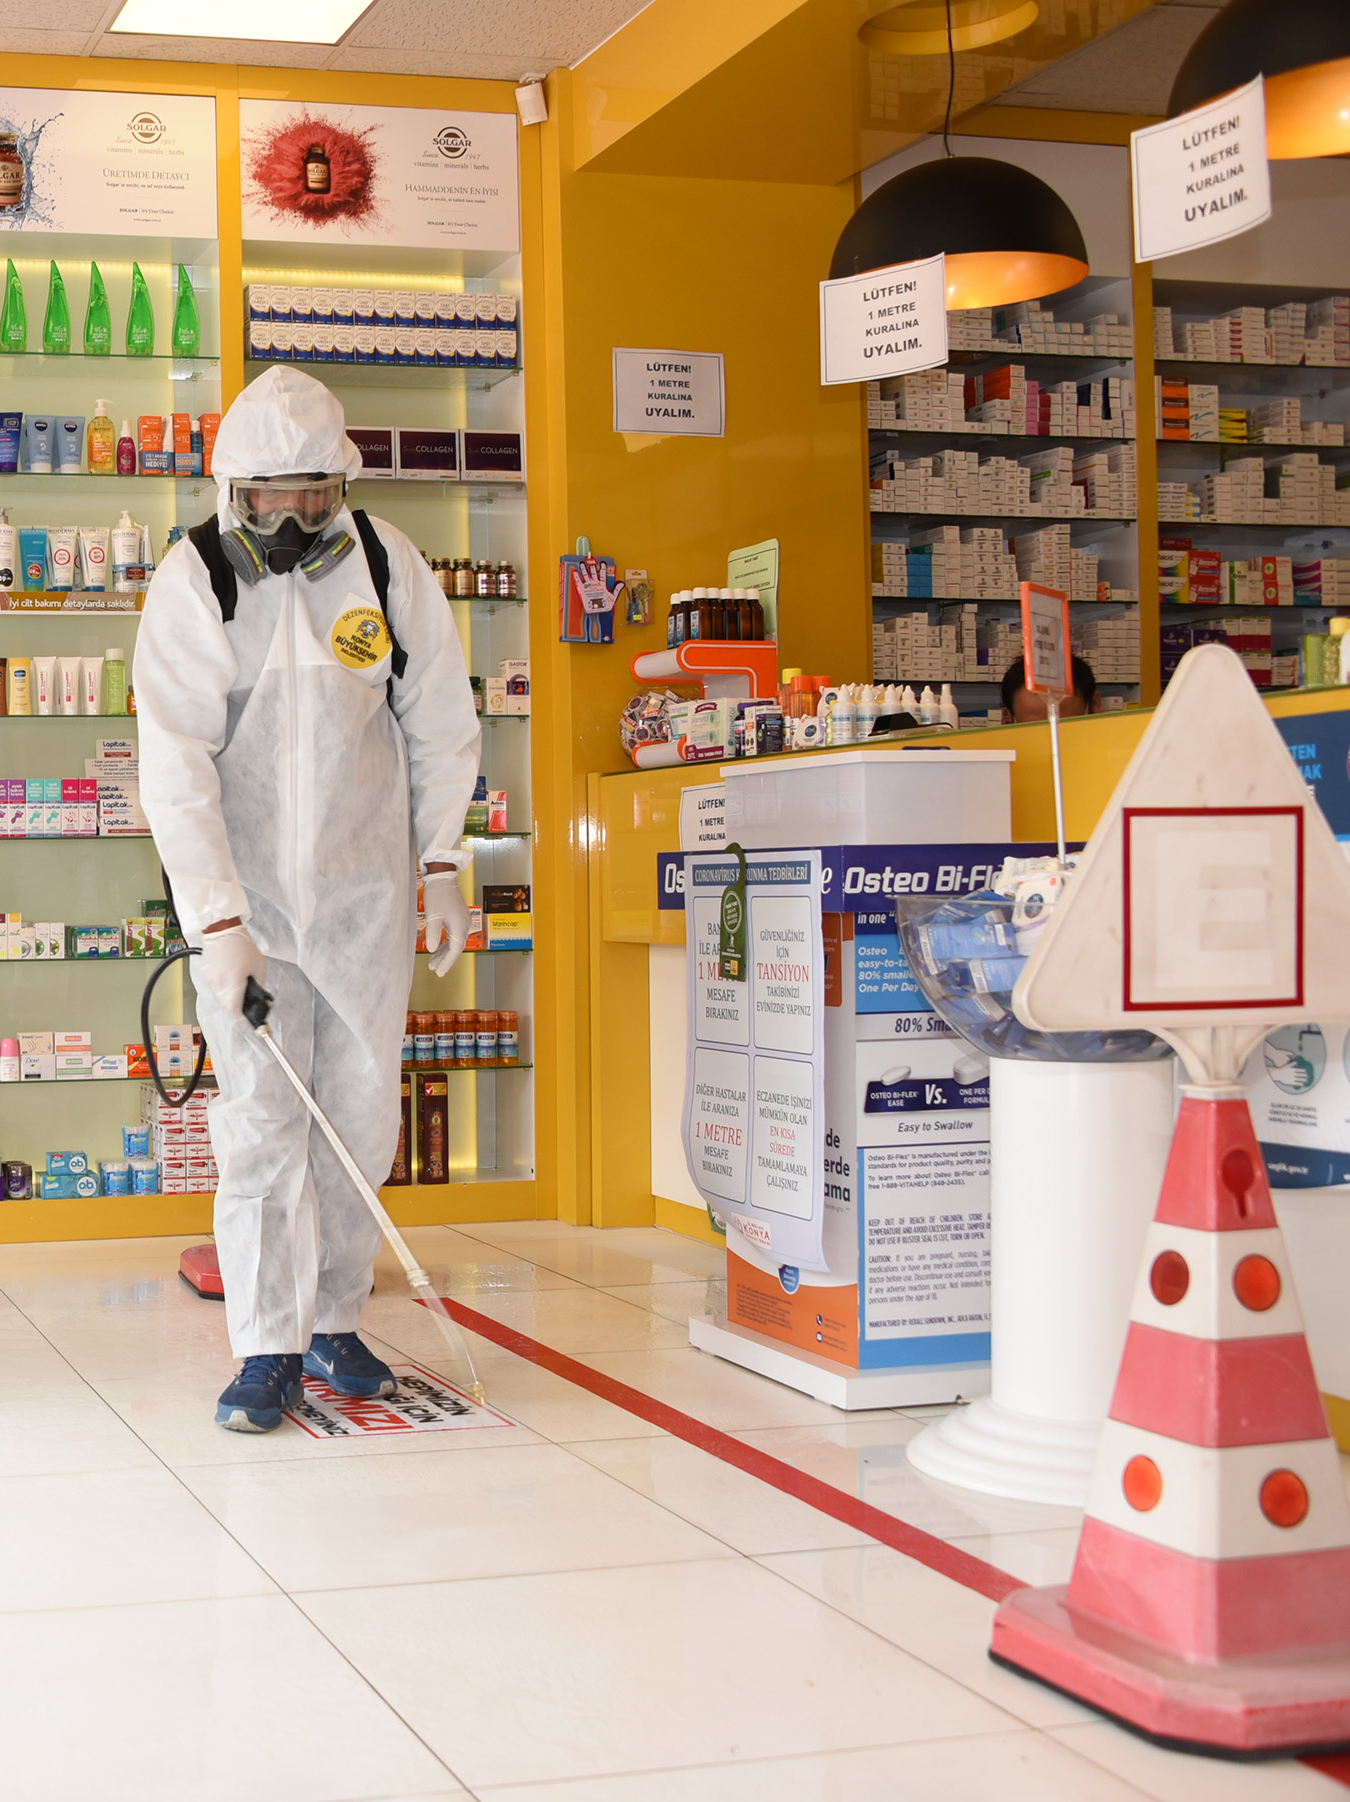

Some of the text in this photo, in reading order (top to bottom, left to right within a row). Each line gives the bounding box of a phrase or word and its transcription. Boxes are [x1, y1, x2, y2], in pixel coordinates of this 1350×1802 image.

[126, 122, 167, 132] SOLGAR
[1182, 114, 1240, 151] LÜTFEN!
[432, 137, 472, 148] SOLGAR
[414, 160, 438, 168] vitamins
[443, 162, 469, 170] minerals
[1188, 143, 1240, 172] 1 METRE
[102, 166, 190, 181] ÜRETİMDE DETAYCI
[1186, 163, 1244, 195] KURALINA
[405, 183, 468, 194] HAMMADDENİN
[470, 187, 480, 195] EN
[1184, 188, 1248, 222] UYALIM.
[863, 281, 917, 302] LÜTFEN!
[868, 302, 916, 320] 1 METRE
[865, 318, 919, 337] KURALINA
[864, 338, 922, 358] UYALIM.
[647, 362, 691, 373] LÜTFEN!
[658, 380, 690, 388] METRE
[648, 393, 693, 401] KURALINA
[645, 408, 695, 418] UYALIM.
[416, 445, 453, 454] COLLAGEN
[480, 447, 518, 455] COLLAGEN
[9, 598, 135, 609] İyi cilt bakımı detaylarda saklıdır.
[335, 636, 377, 661] BÜYÜKŞEHİR
[351, 635, 371, 648] KONYA
[698, 798, 725, 809] LÜTFEN!
[705, 817, 724, 826] METRE
[699, 832, 725, 841] KURALINA
[768, 864, 807, 881] TEDBİRLERİ
[844, 865, 1003, 894] Osteo Bi-Fl
[858, 913, 886, 925] in one
[760, 929, 805, 942] GÜVENLİĞİNİZ
[699, 940, 710, 955] İLE
[776, 947, 789, 960] İÇİN
[858, 946, 887, 956] Osteo
[699, 962, 704, 980] 1
[757, 960, 809, 982] TANSİYON
[858, 972, 881, 980] 80%
[707, 988, 735, 1002] MESAFE
[766, 985, 800, 999] TAKİBİNİZİ
[859, 983, 920, 993] One Per Day
[706, 1007, 739, 1021] BIRAKINIZ
[757, 1001, 811, 1016] EVİNİZDE YAPINIZ
[895, 1018, 922, 1033] 80%
[696, 1083, 747, 1102] DİĞER HASTALAR
[756, 1090, 812, 1110] ECZANEDE İŞİNİZİ
[925, 1084, 947, 1104] Vs.
[964, 1096, 990, 1104] FORMUL
[701, 1099, 739, 1117] İLE ARANIZA
[759, 1107, 808, 1126] MÜMKÜN OLAN
[770, 1125, 796, 1141] EN KISA
[898, 1120, 973, 1133] Easy to Swallow
[695, 1122, 742, 1147] 1 METRE
[704, 1145, 729, 1160] MESAFE
[769, 1142, 796, 1158] SÜREDE
[702, 1160, 732, 1177] BIRAKINIZ
[758, 1155, 808, 1178] TAMAMLAMAYA
[766, 1175, 798, 1192] ÇALIŞINIZ
[743, 1223, 771, 1241] KONYA
